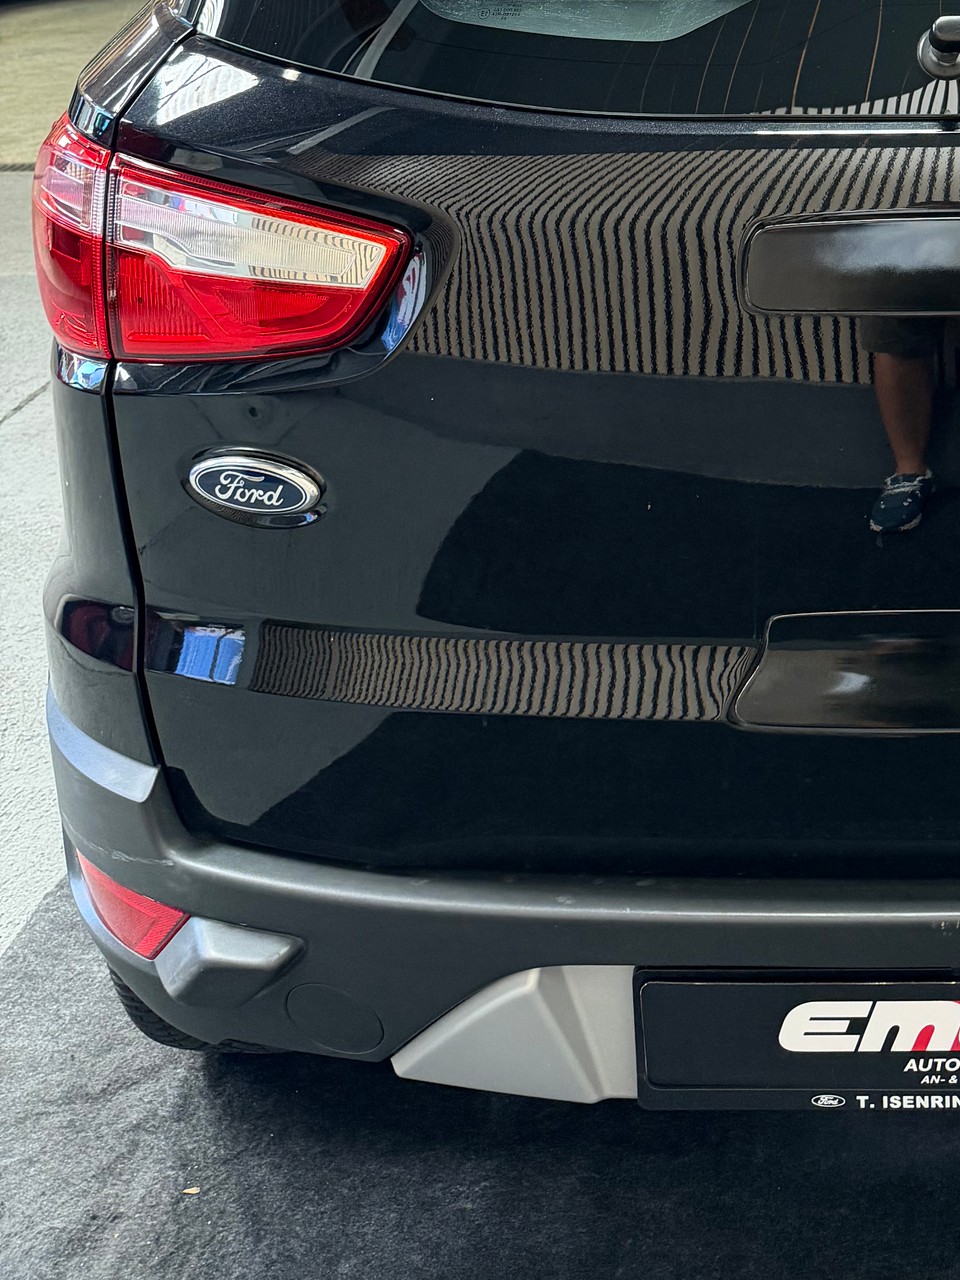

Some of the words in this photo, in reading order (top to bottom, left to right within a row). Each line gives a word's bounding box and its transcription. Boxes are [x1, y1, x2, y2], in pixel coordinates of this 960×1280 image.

[214, 470, 284, 506] Ford
[920, 1075, 946, 1084] AN-
[948, 1075, 959, 1084] &
[856, 1095, 875, 1109] T.
